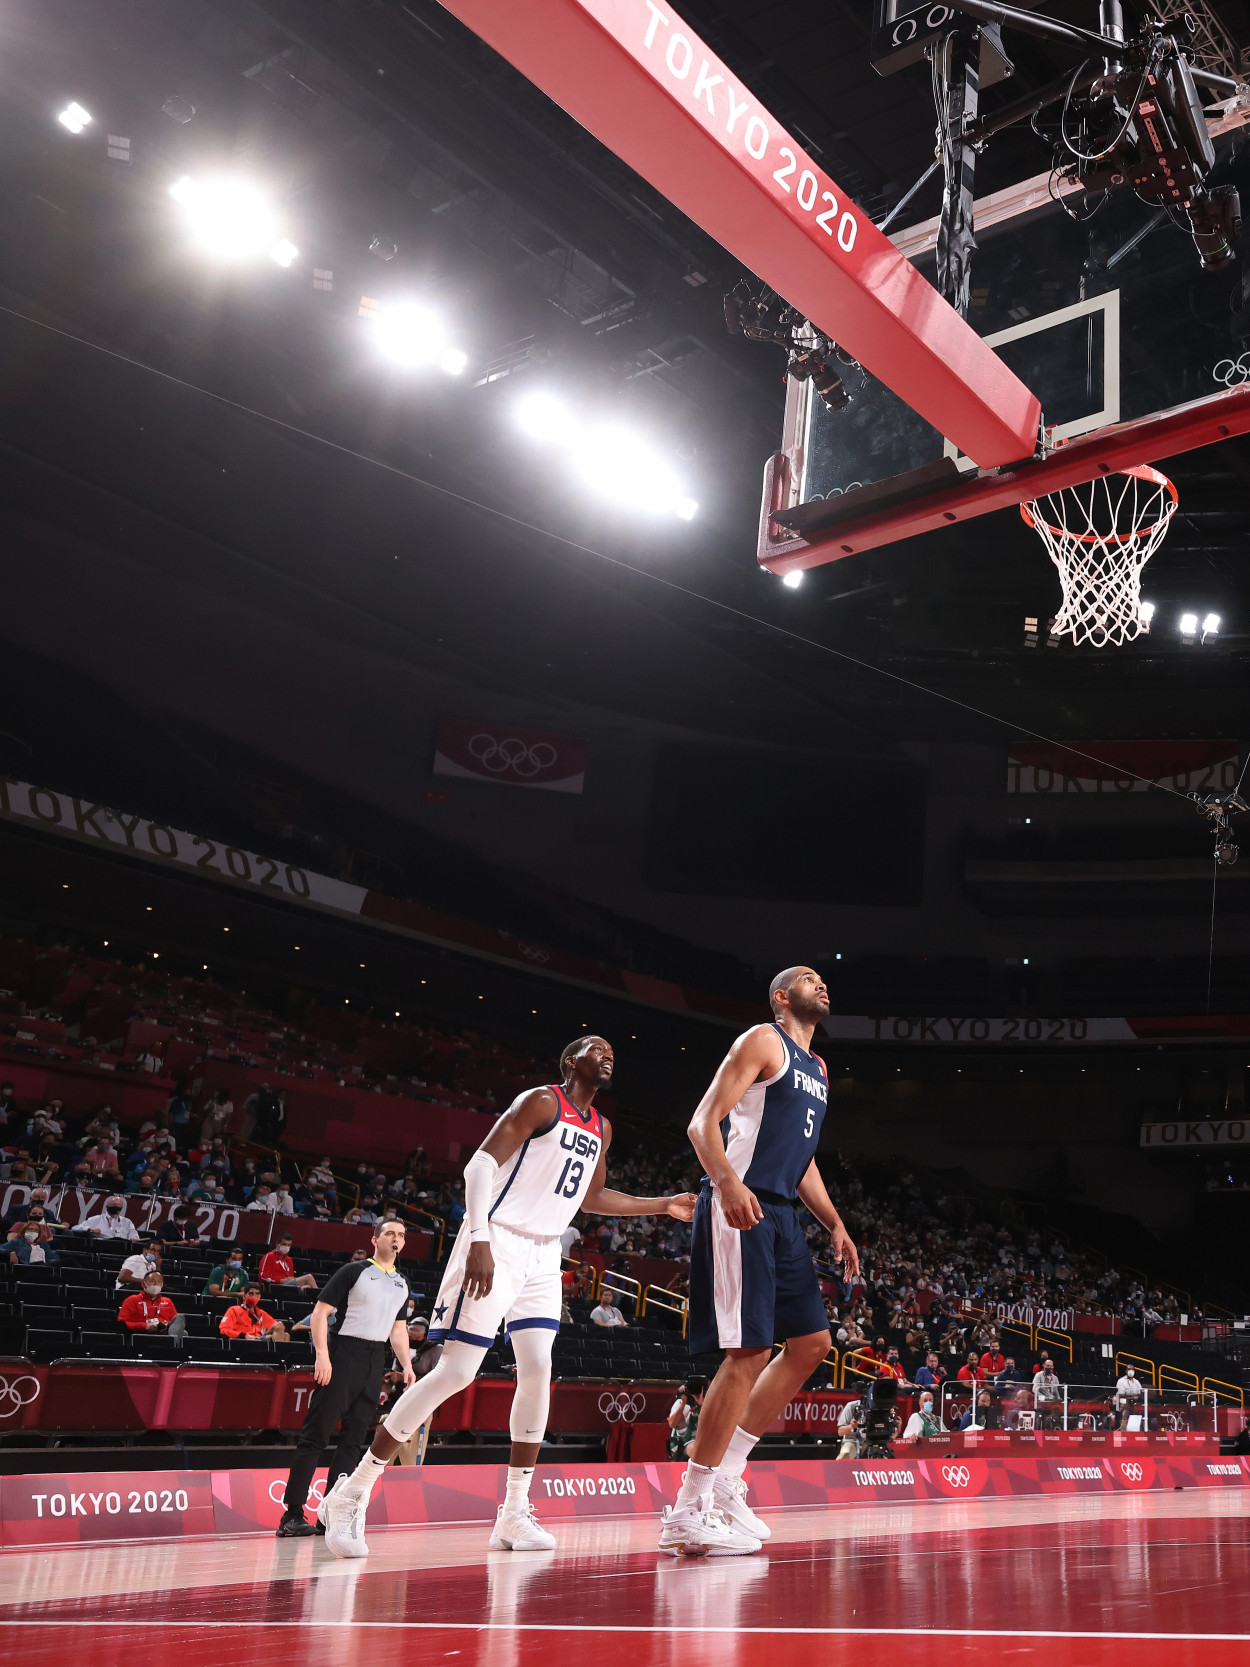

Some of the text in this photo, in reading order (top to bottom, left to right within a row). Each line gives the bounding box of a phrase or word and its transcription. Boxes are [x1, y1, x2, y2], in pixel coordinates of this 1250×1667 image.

[644, 0, 858, 252] TOKYO 2020
[1008, 761, 1239, 793] TOKYO 2020
[0, 776, 310, 898] TOKYO 2020
[868, 1016, 1088, 1040] TOKYO 2020
[793, 1069, 827, 1105] FRANCE
[804, 1107, 815, 1138] 5
[1142, 1122, 1245, 1144] TOKYO
[560, 1127, 598, 1161] USA
[554, 1157, 584, 1199] 13
[1037, 1309, 1067, 1330] 2020
[777, 1402, 819, 1421] OKYO
[852, 1471, 914, 1486] TOKYO 2020
[1057, 1467, 1102, 1479] TOKYO 2020
[1207, 1465, 1242, 1475] TOKYO 2020
[543, 1477, 636, 1497] TOKYO 2020
[32, 1489, 189, 1517] TOKYO 2020
